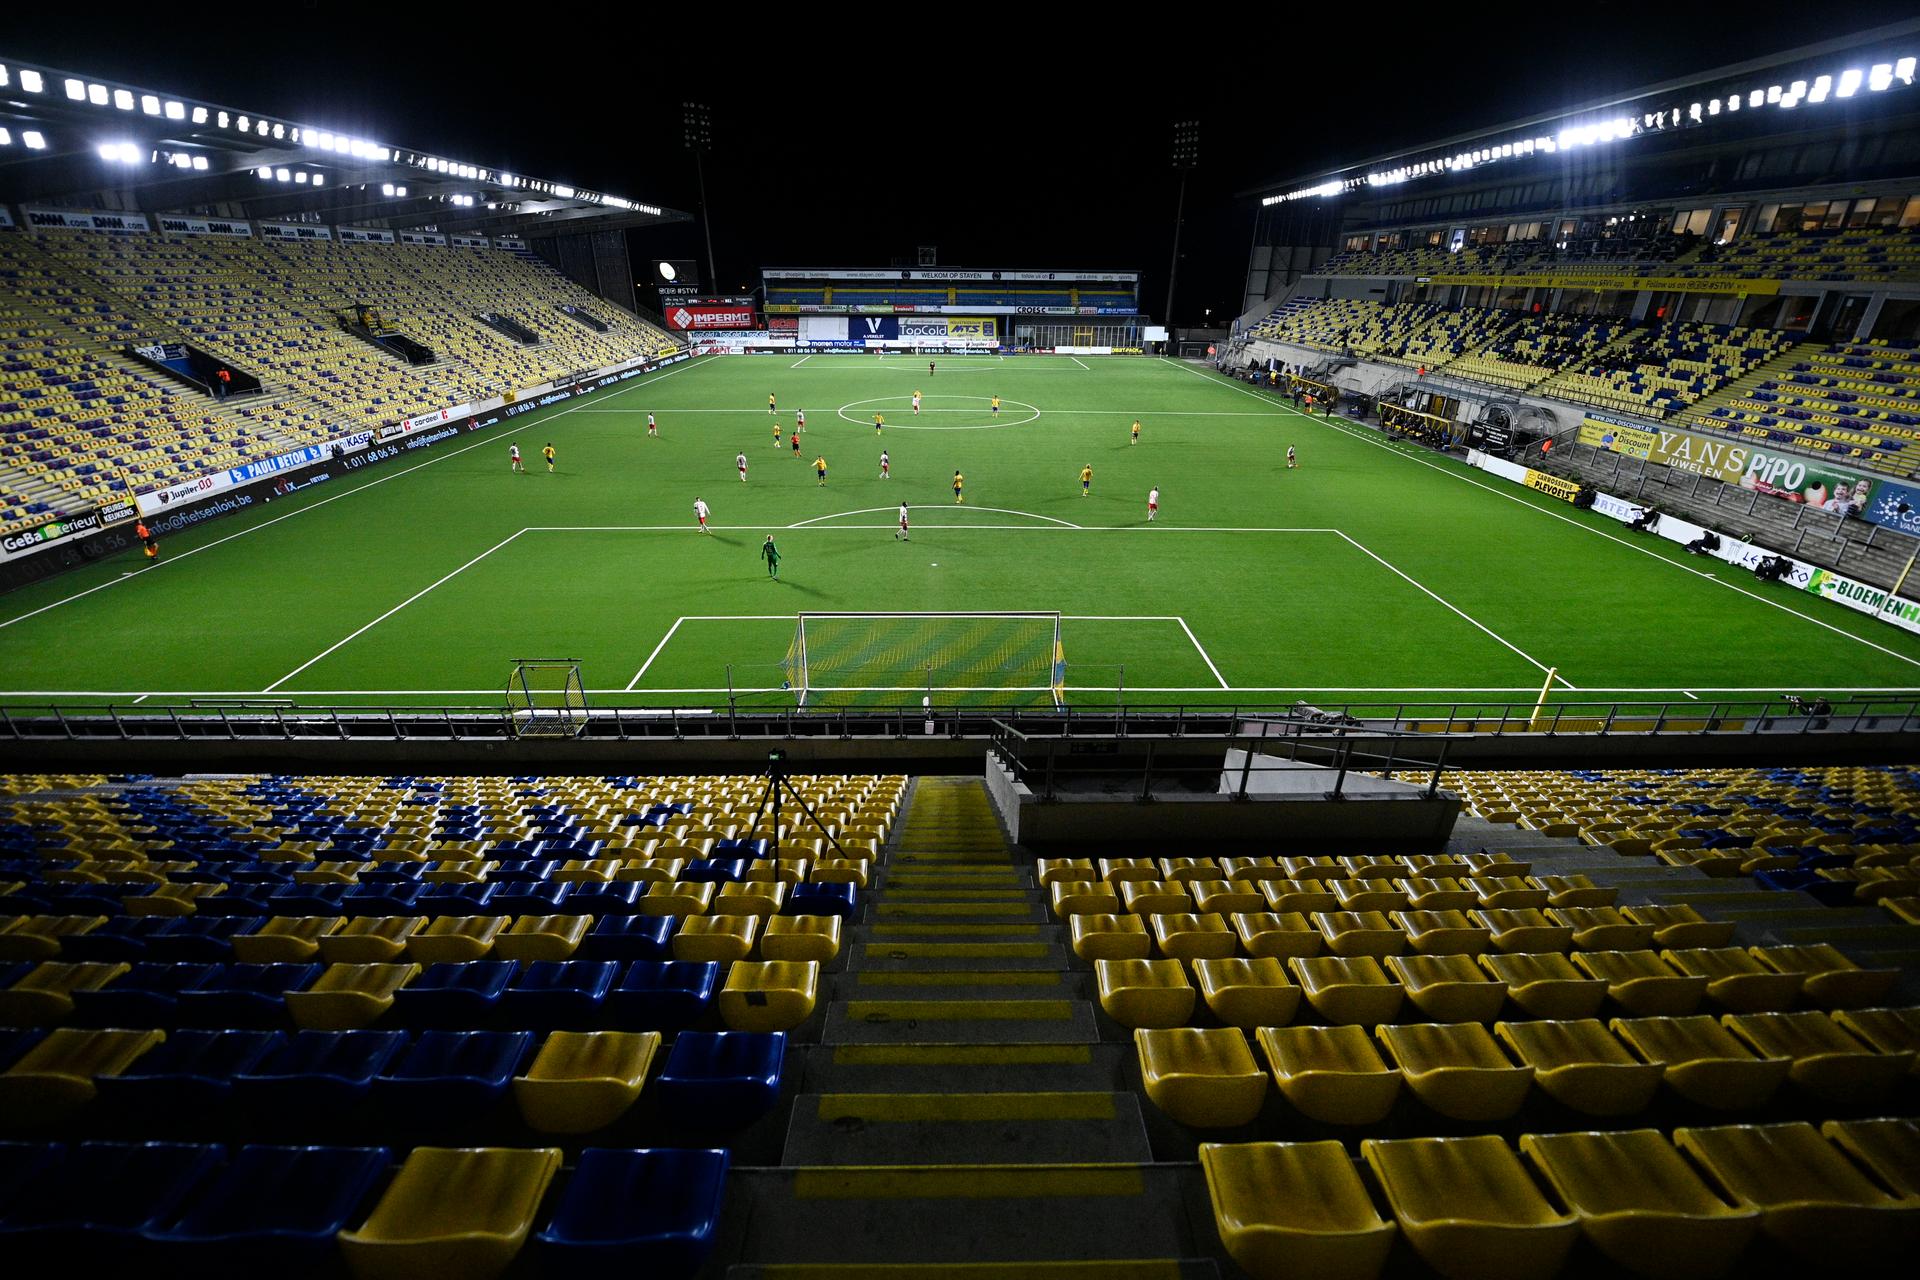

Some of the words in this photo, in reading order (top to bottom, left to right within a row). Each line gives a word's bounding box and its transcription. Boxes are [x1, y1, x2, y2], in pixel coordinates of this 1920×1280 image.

[693, 313, 750, 322] IMPERMO
[900, 325, 947, 336] TopCold
[951, 325, 979, 333] MTS
[1618, 435, 1651, 450] Discount
[352, 455, 367, 468] 011
[367, 452, 379, 463] 68
[379, 449, 389, 460] 06
[388, 445, 399, 456] 56
[1657, 431, 1747, 473] YANS
[247, 460, 276, 478] PAULI
[278, 449, 307, 470] BETON
[1663, 457, 1723, 479] JUWELEN
[1537, 473, 1573, 490] CARROSSERIE
[170, 485, 199, 501] Jupiler
[103, 507, 134, 523] KEUKENS
[149, 494, 253, 536] nfo@fietsenloix.be
